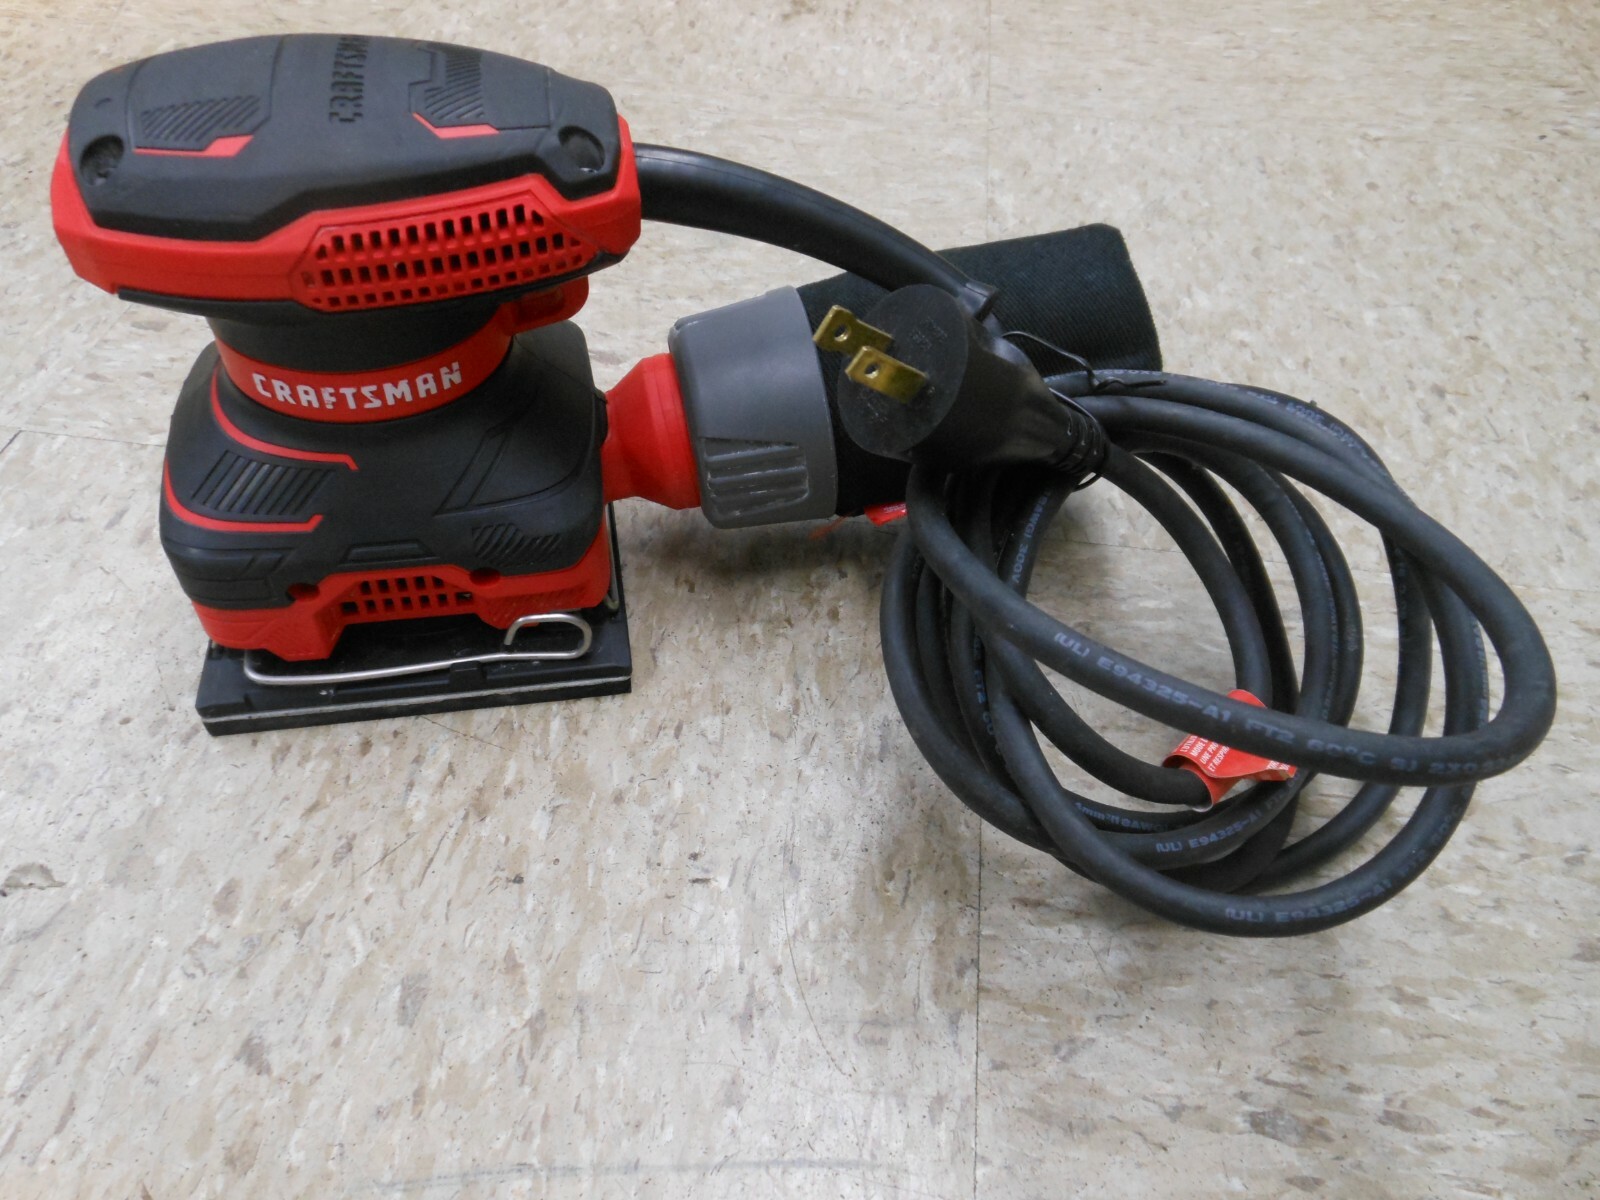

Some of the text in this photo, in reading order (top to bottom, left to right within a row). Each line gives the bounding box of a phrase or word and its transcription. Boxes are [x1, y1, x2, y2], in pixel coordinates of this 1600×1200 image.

[328, 36, 369, 124] CRAFTSMA
[252, 361, 462, 409] CRAFTSMAN
[1054, 634, 1090, 658] (UL)
[1096, 655, 1232, 722] E94325-A1
[1189, 809, 1262, 849] E94325-A1
